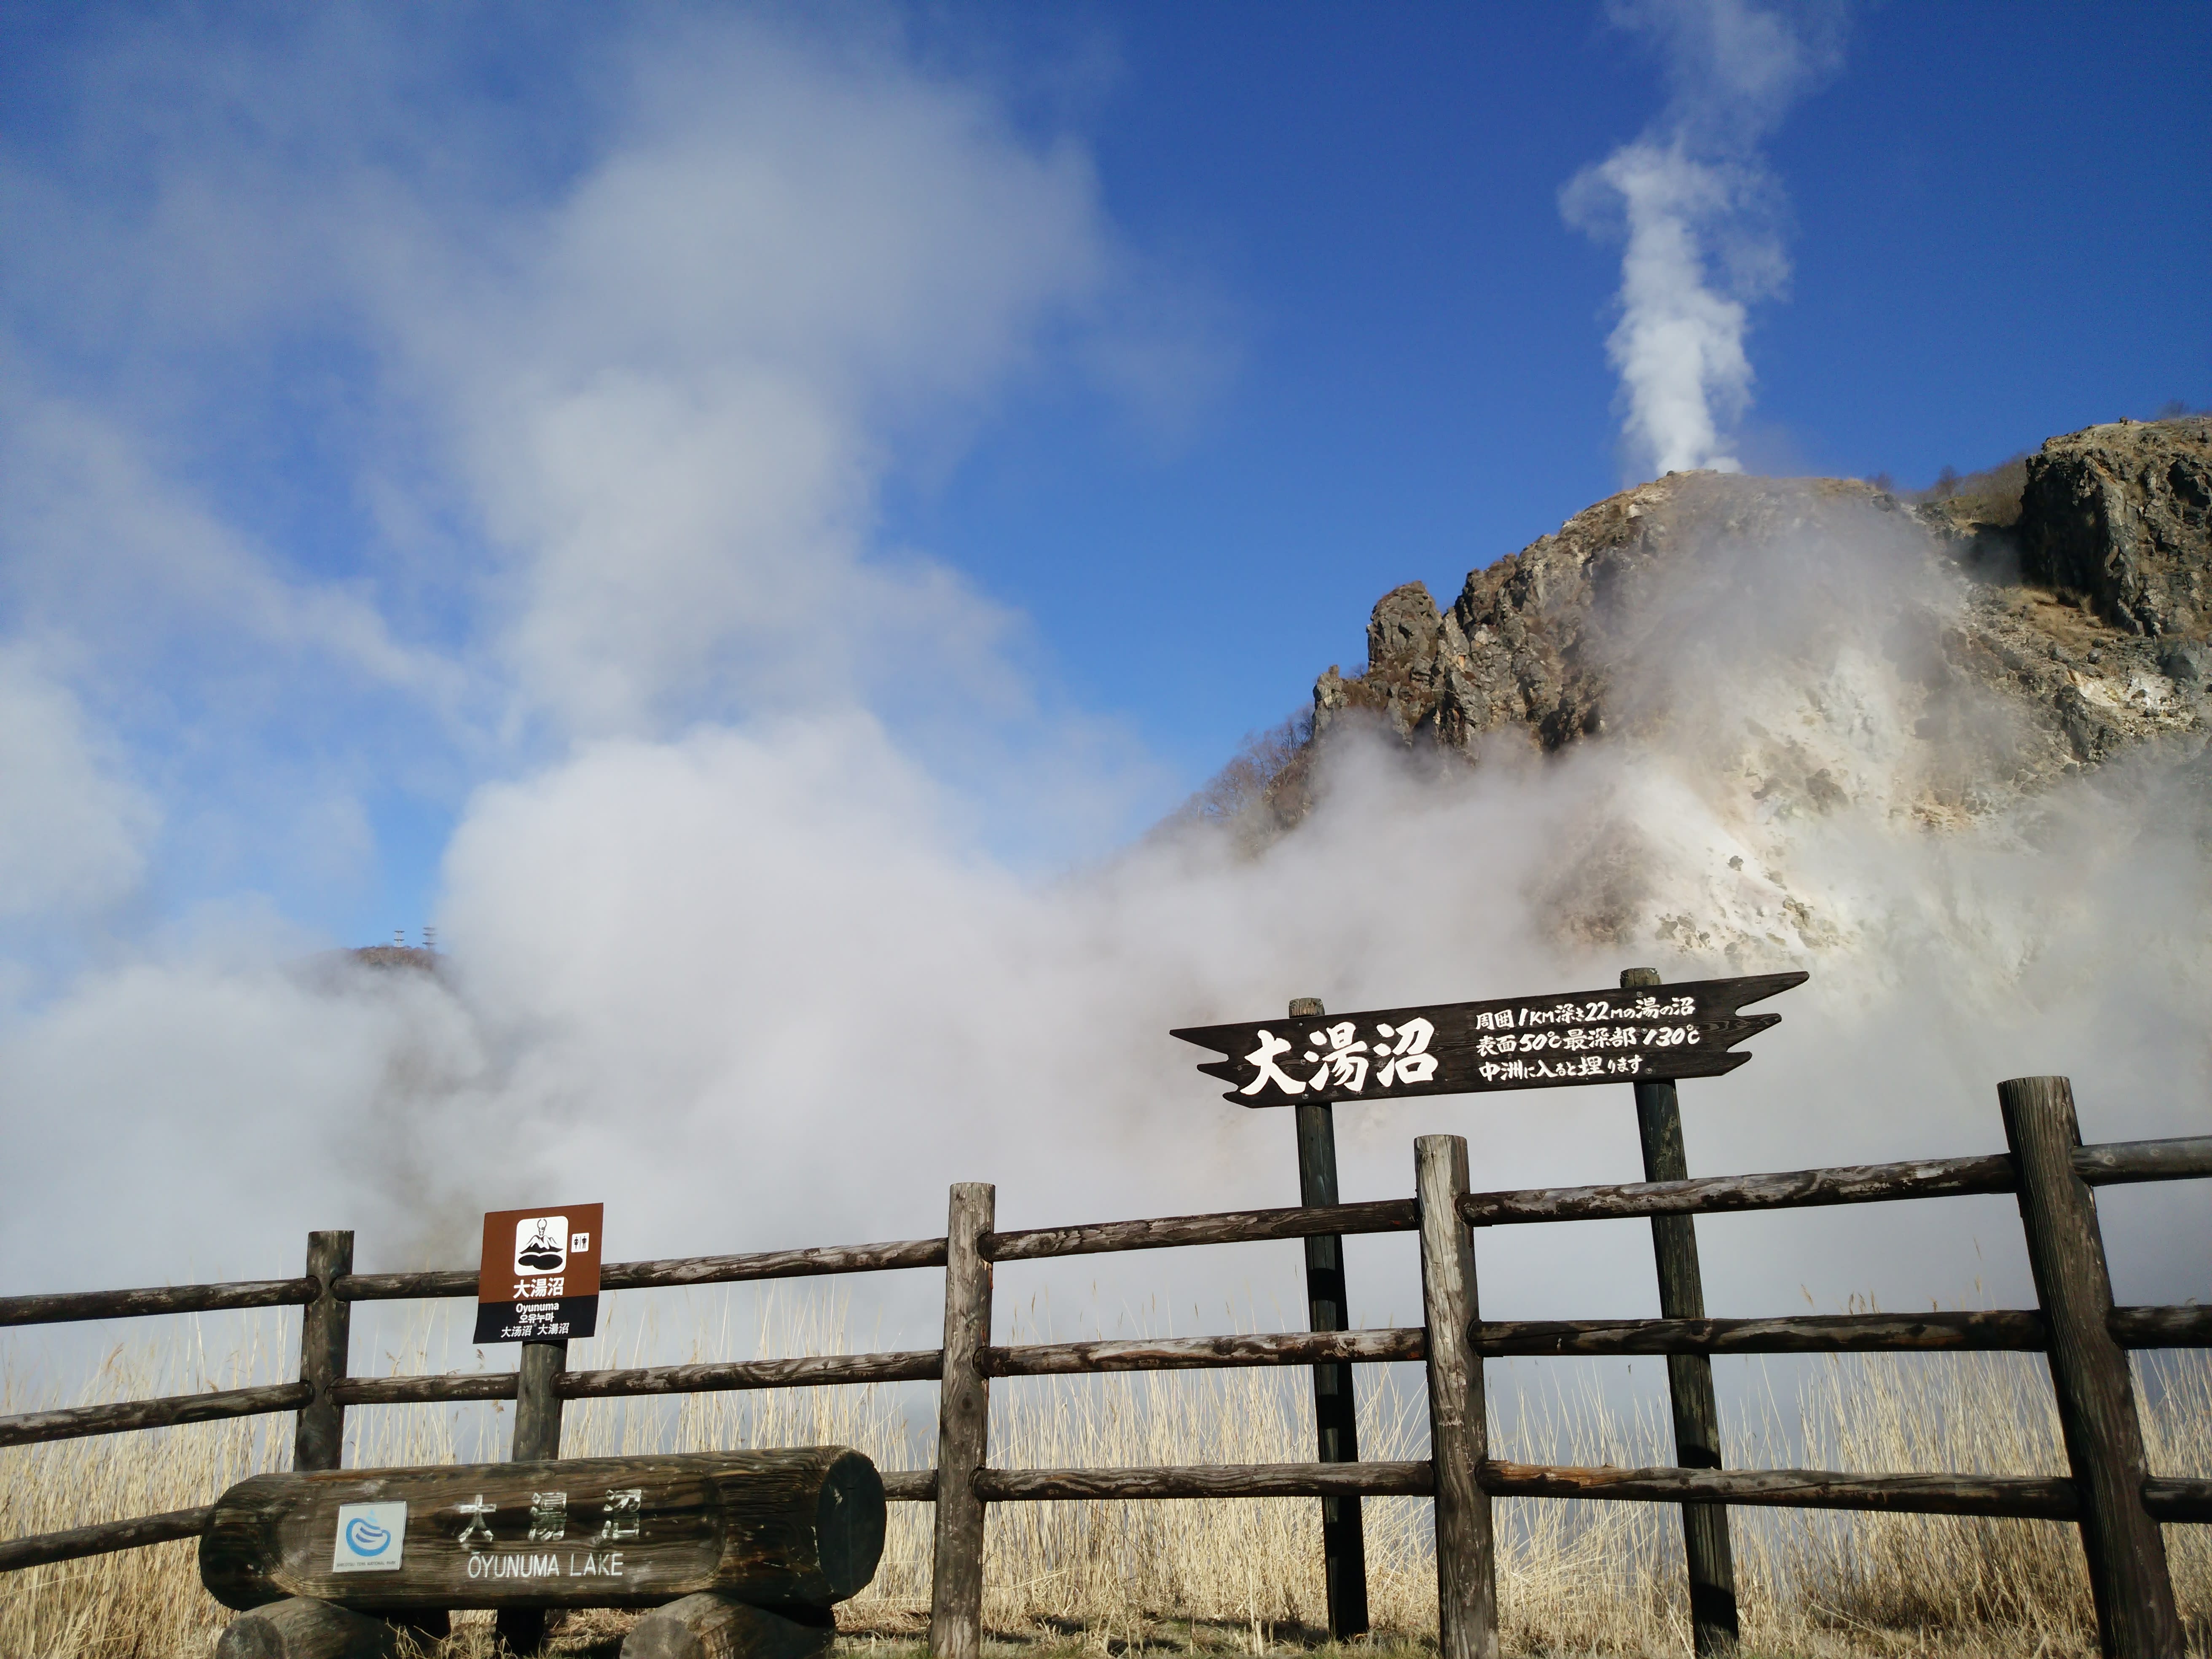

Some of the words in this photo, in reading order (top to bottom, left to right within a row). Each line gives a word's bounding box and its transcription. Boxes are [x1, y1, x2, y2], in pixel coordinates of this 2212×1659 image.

[1240, 1017, 1438, 1095] 大湯沼
[1479, 1054, 1643, 1081] 中洲に入ると埋ります
[513, 1277, 564, 1299] 大湯沼
[516, 1302, 559, 1315] Oyunuma
[518, 1312, 554, 1323] 오유누마
[501, 1325, 532, 1338] 大汤沼
[537, 1323, 569, 1335] 大湯沼
[570, 1553, 623, 1576] LAKE
